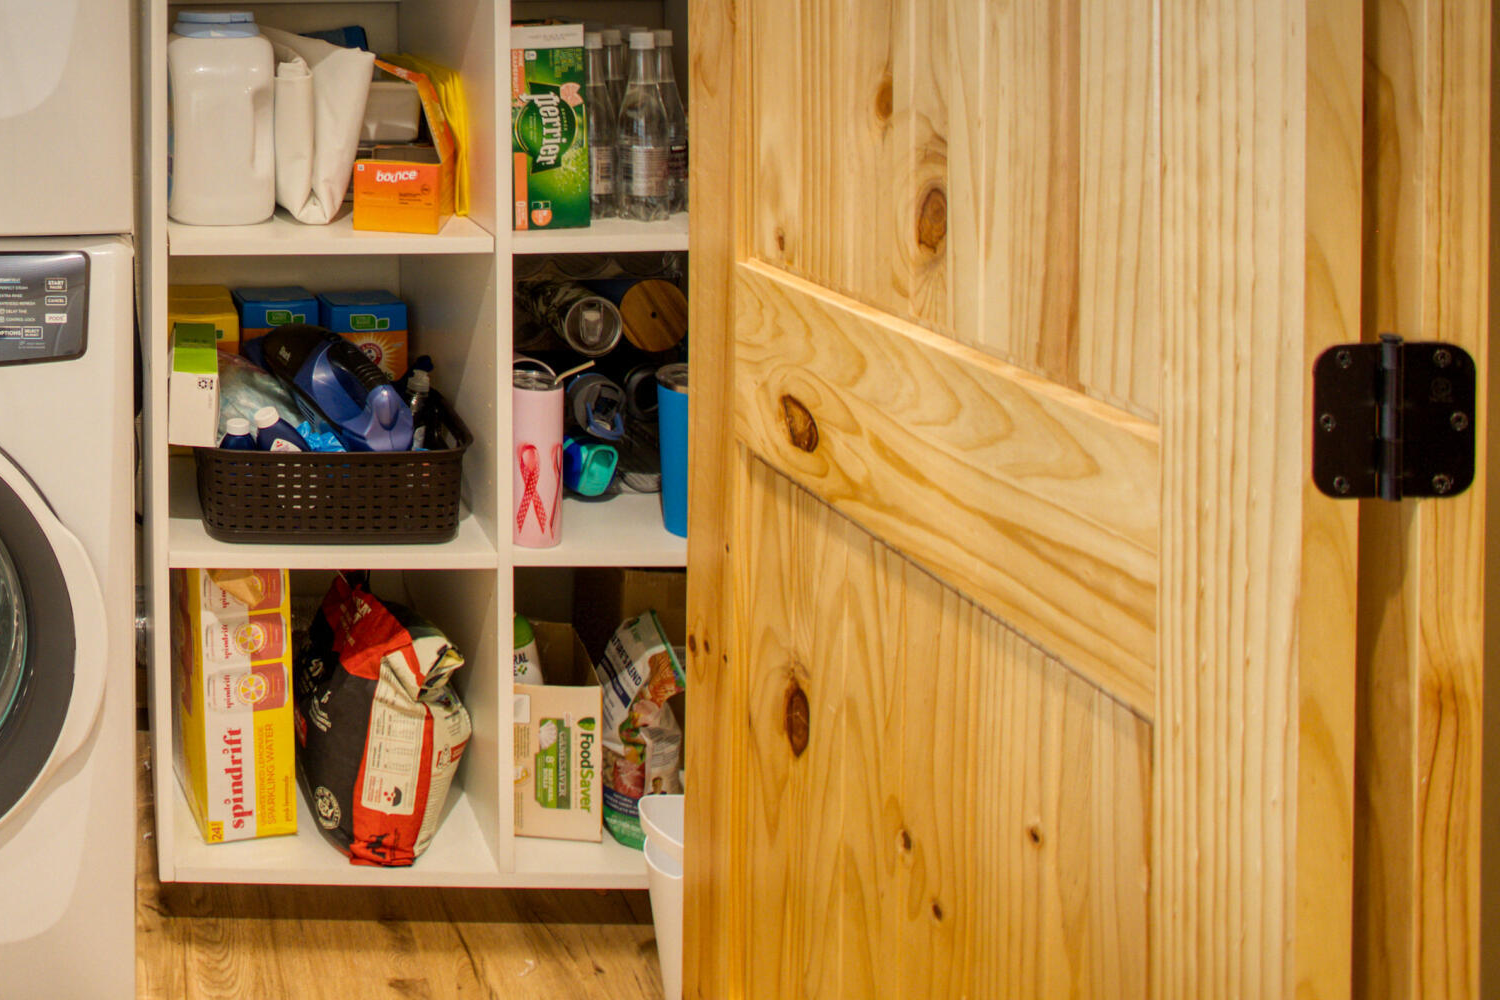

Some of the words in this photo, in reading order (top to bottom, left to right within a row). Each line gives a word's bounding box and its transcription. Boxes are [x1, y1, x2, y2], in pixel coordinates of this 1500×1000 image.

[519, 91, 567, 166] perrier
[376, 169, 418, 183] bounce
[223, 623, 231, 660] spindrift
[224, 674, 232, 709] spindrift
[624, 662, 642, 686] BLEND
[265, 724, 274, 762] WATER
[558, 731, 567, 797] GAMESAVER
[223, 727, 253, 829] spindrift
[267, 765, 276, 825] SPARKLING
[580, 733, 595, 814] FoodSaver
